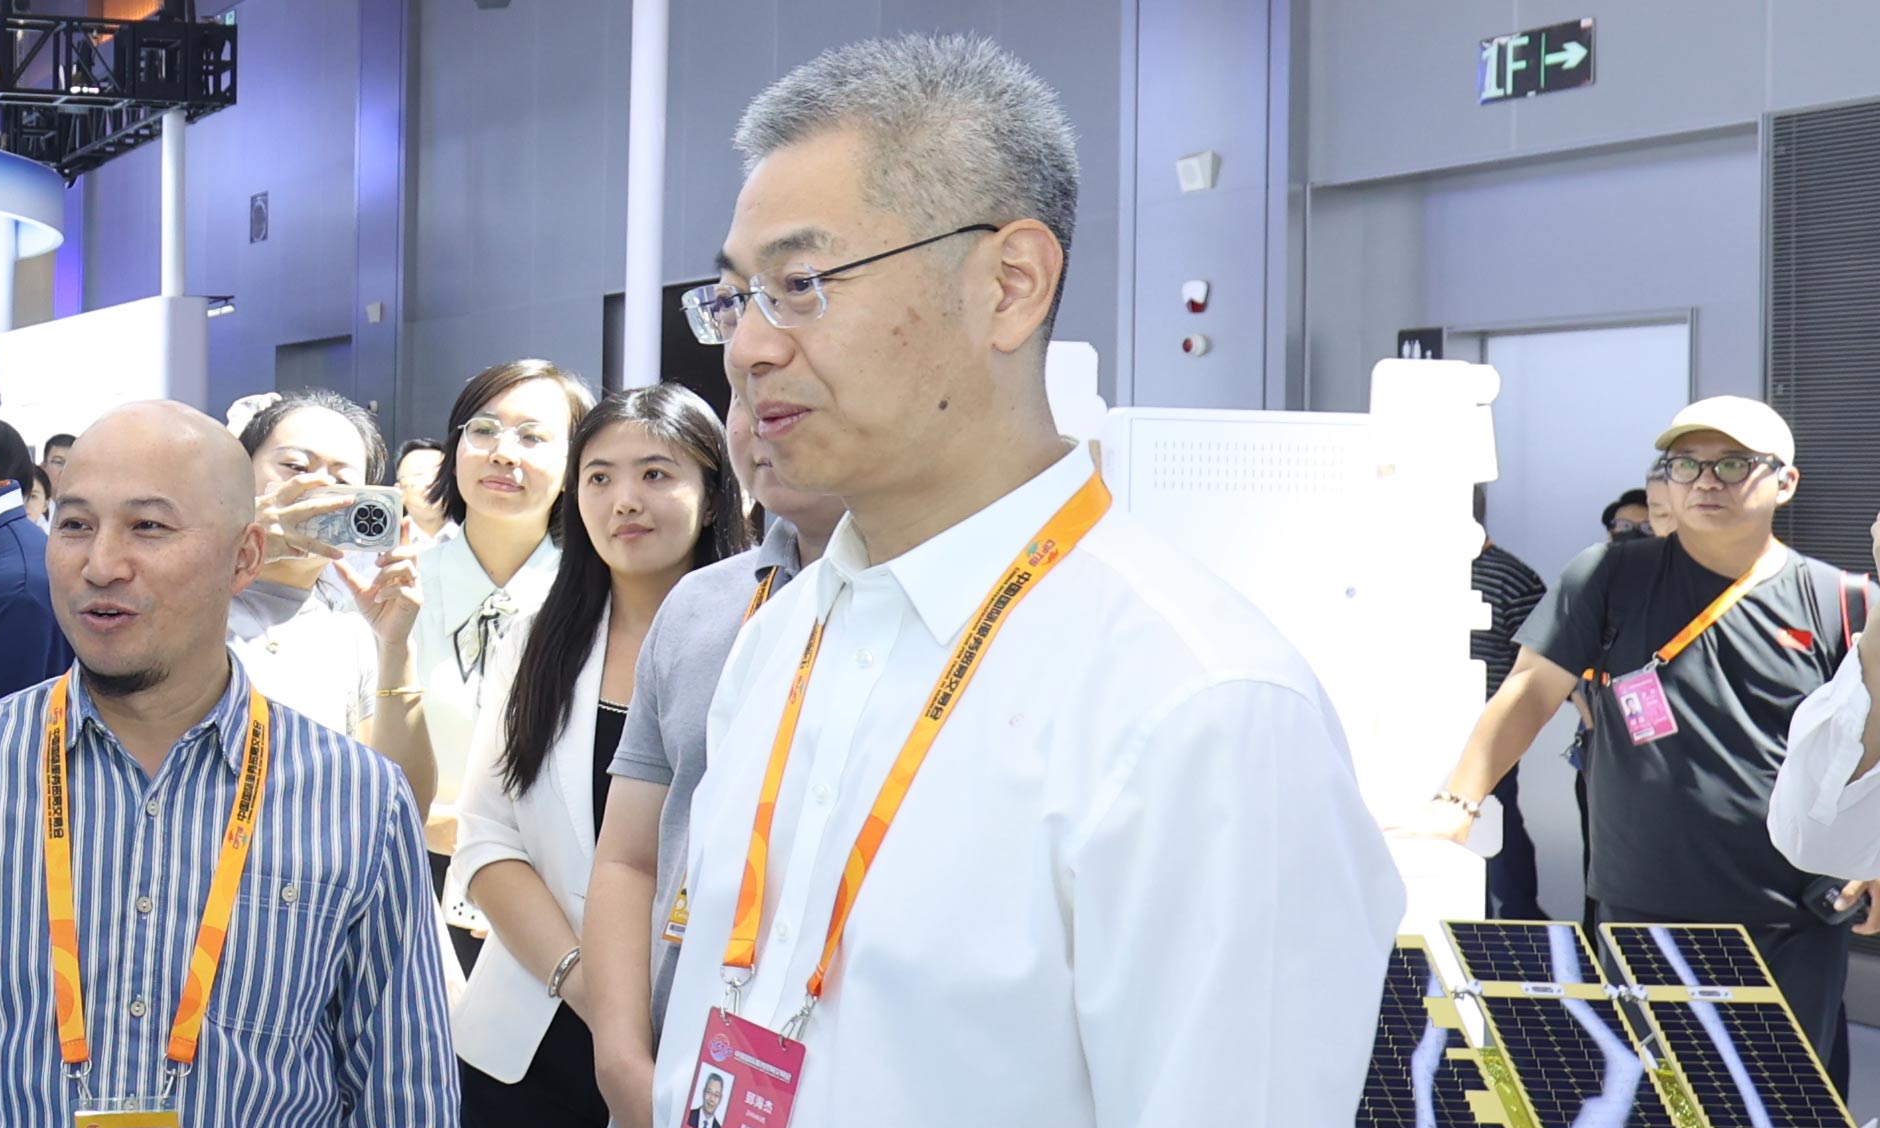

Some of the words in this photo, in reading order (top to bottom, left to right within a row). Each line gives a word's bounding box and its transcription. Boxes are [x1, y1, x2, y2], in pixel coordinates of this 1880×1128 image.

[930, 571, 1032, 720] 中国国际服务贸易交易会
[51, 728, 64, 838] 中国国际服务贸易交易会
[237, 720, 262, 822] 中国国际服务贸易交易会
